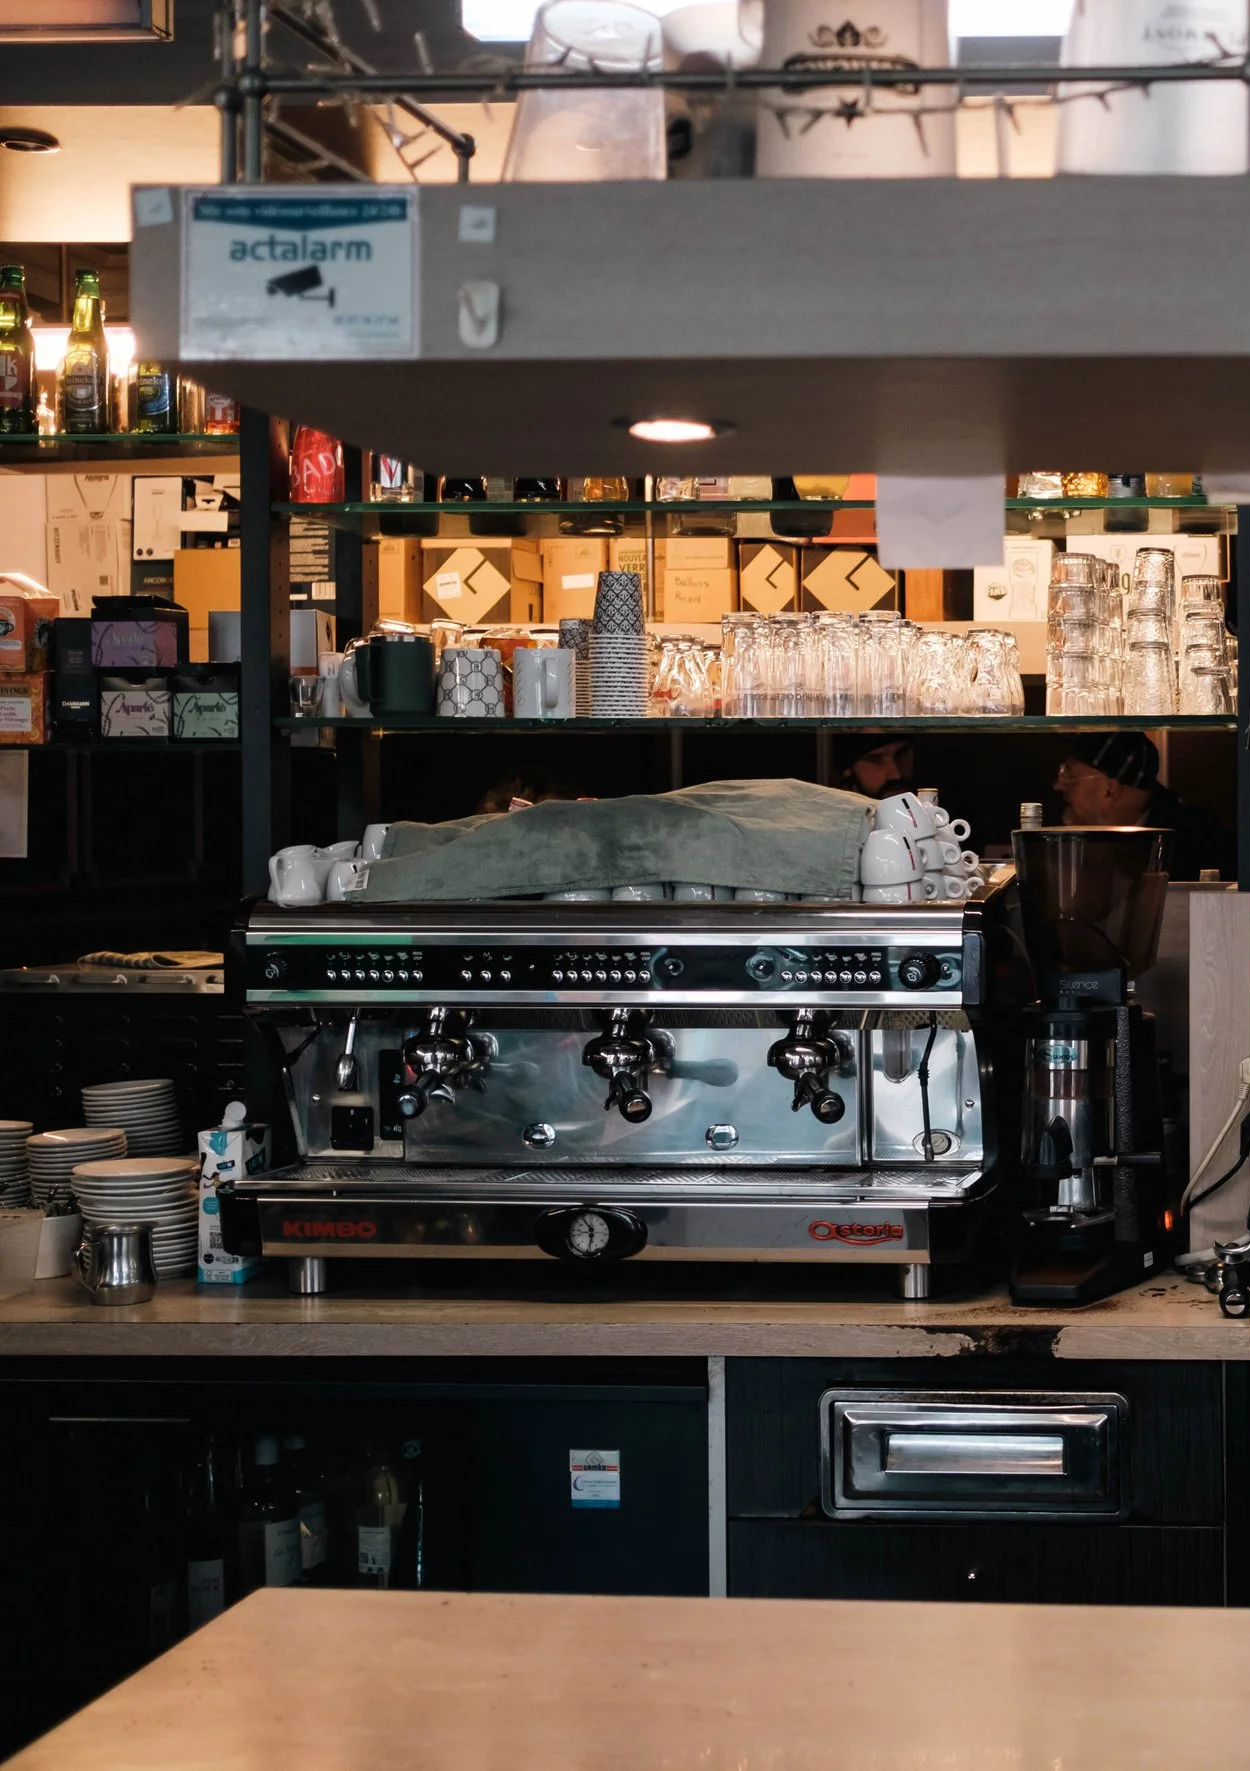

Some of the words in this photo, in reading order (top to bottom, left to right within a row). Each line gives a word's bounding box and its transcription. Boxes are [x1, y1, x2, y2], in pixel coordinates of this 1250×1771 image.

[229, 235, 373, 262] actalarm
[619, 563, 647, 573] VERR
[1059, 980, 1099, 989] Silence
[283, 1221, 377, 1238] KIMBO
